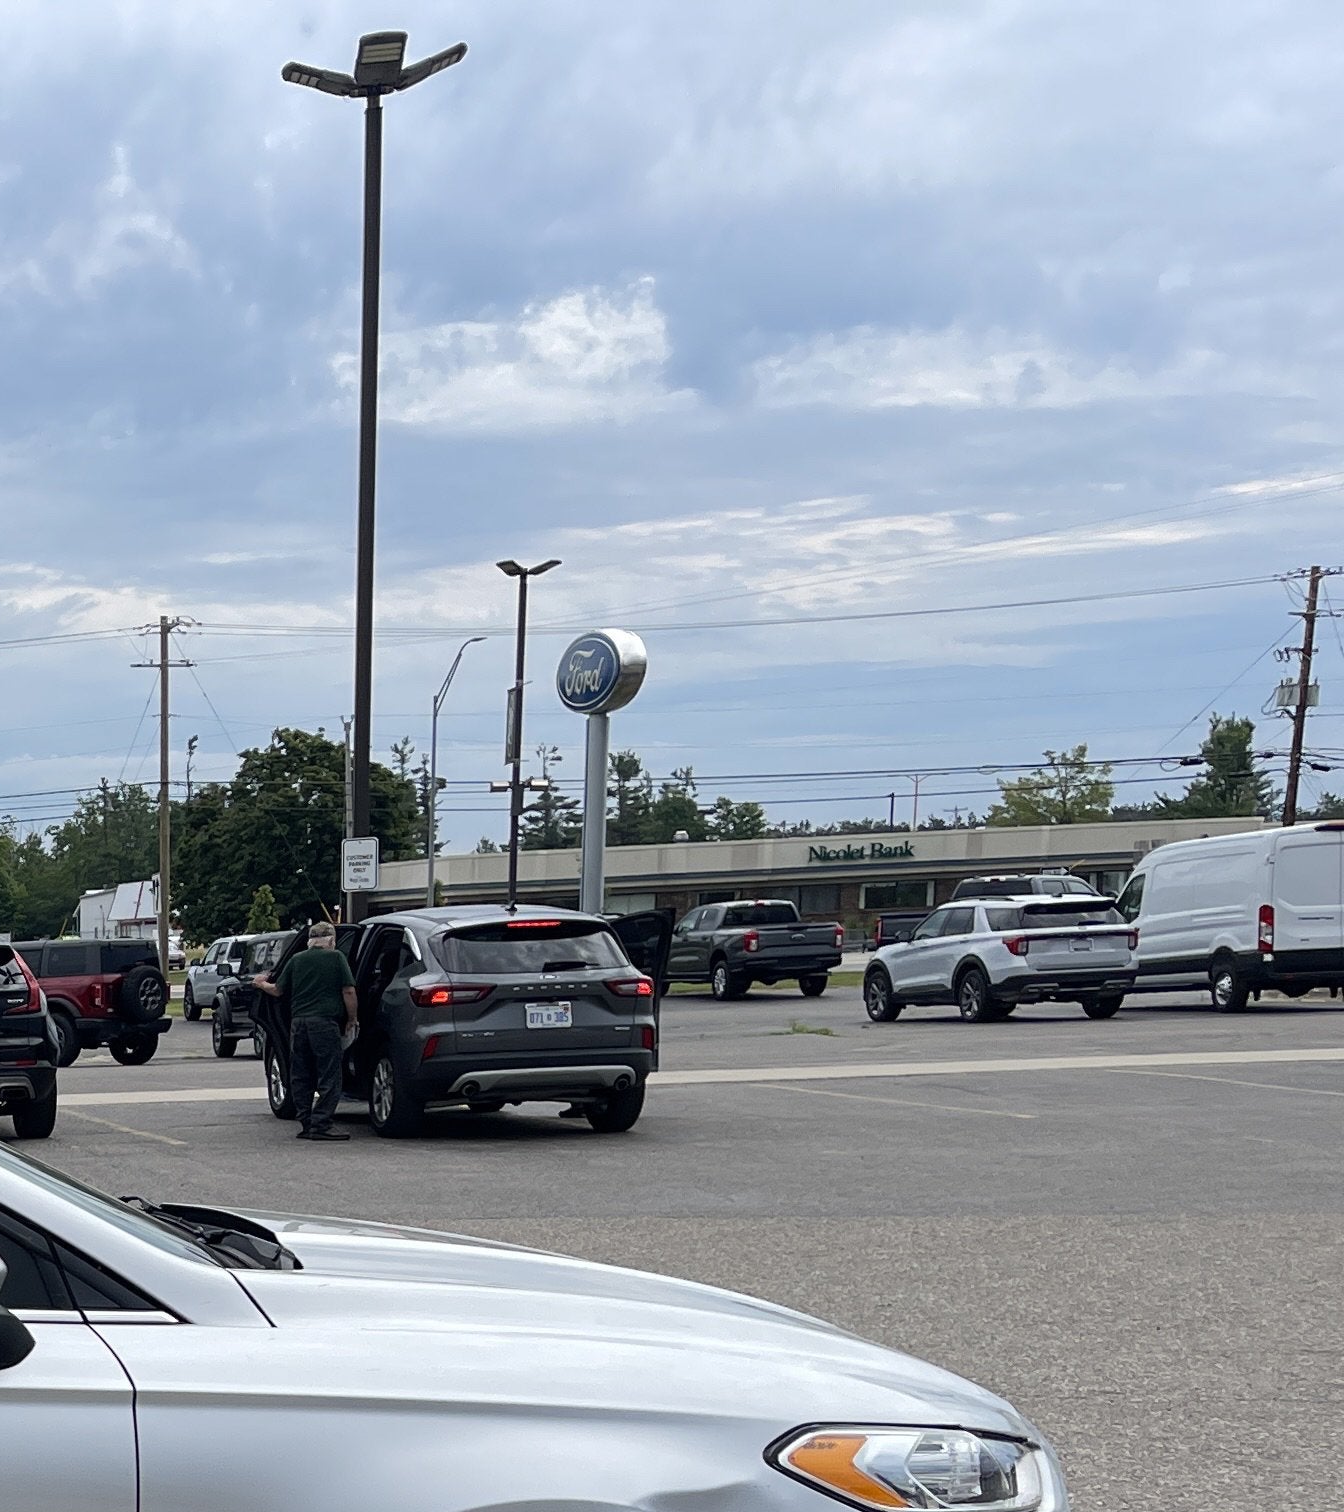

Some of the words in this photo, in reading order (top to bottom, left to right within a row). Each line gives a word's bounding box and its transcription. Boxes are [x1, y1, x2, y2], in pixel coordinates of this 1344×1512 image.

[565, 649, 605, 697] Ford
[808, 844, 865, 863] Nicolet
[870, 840, 915, 859] Bank
